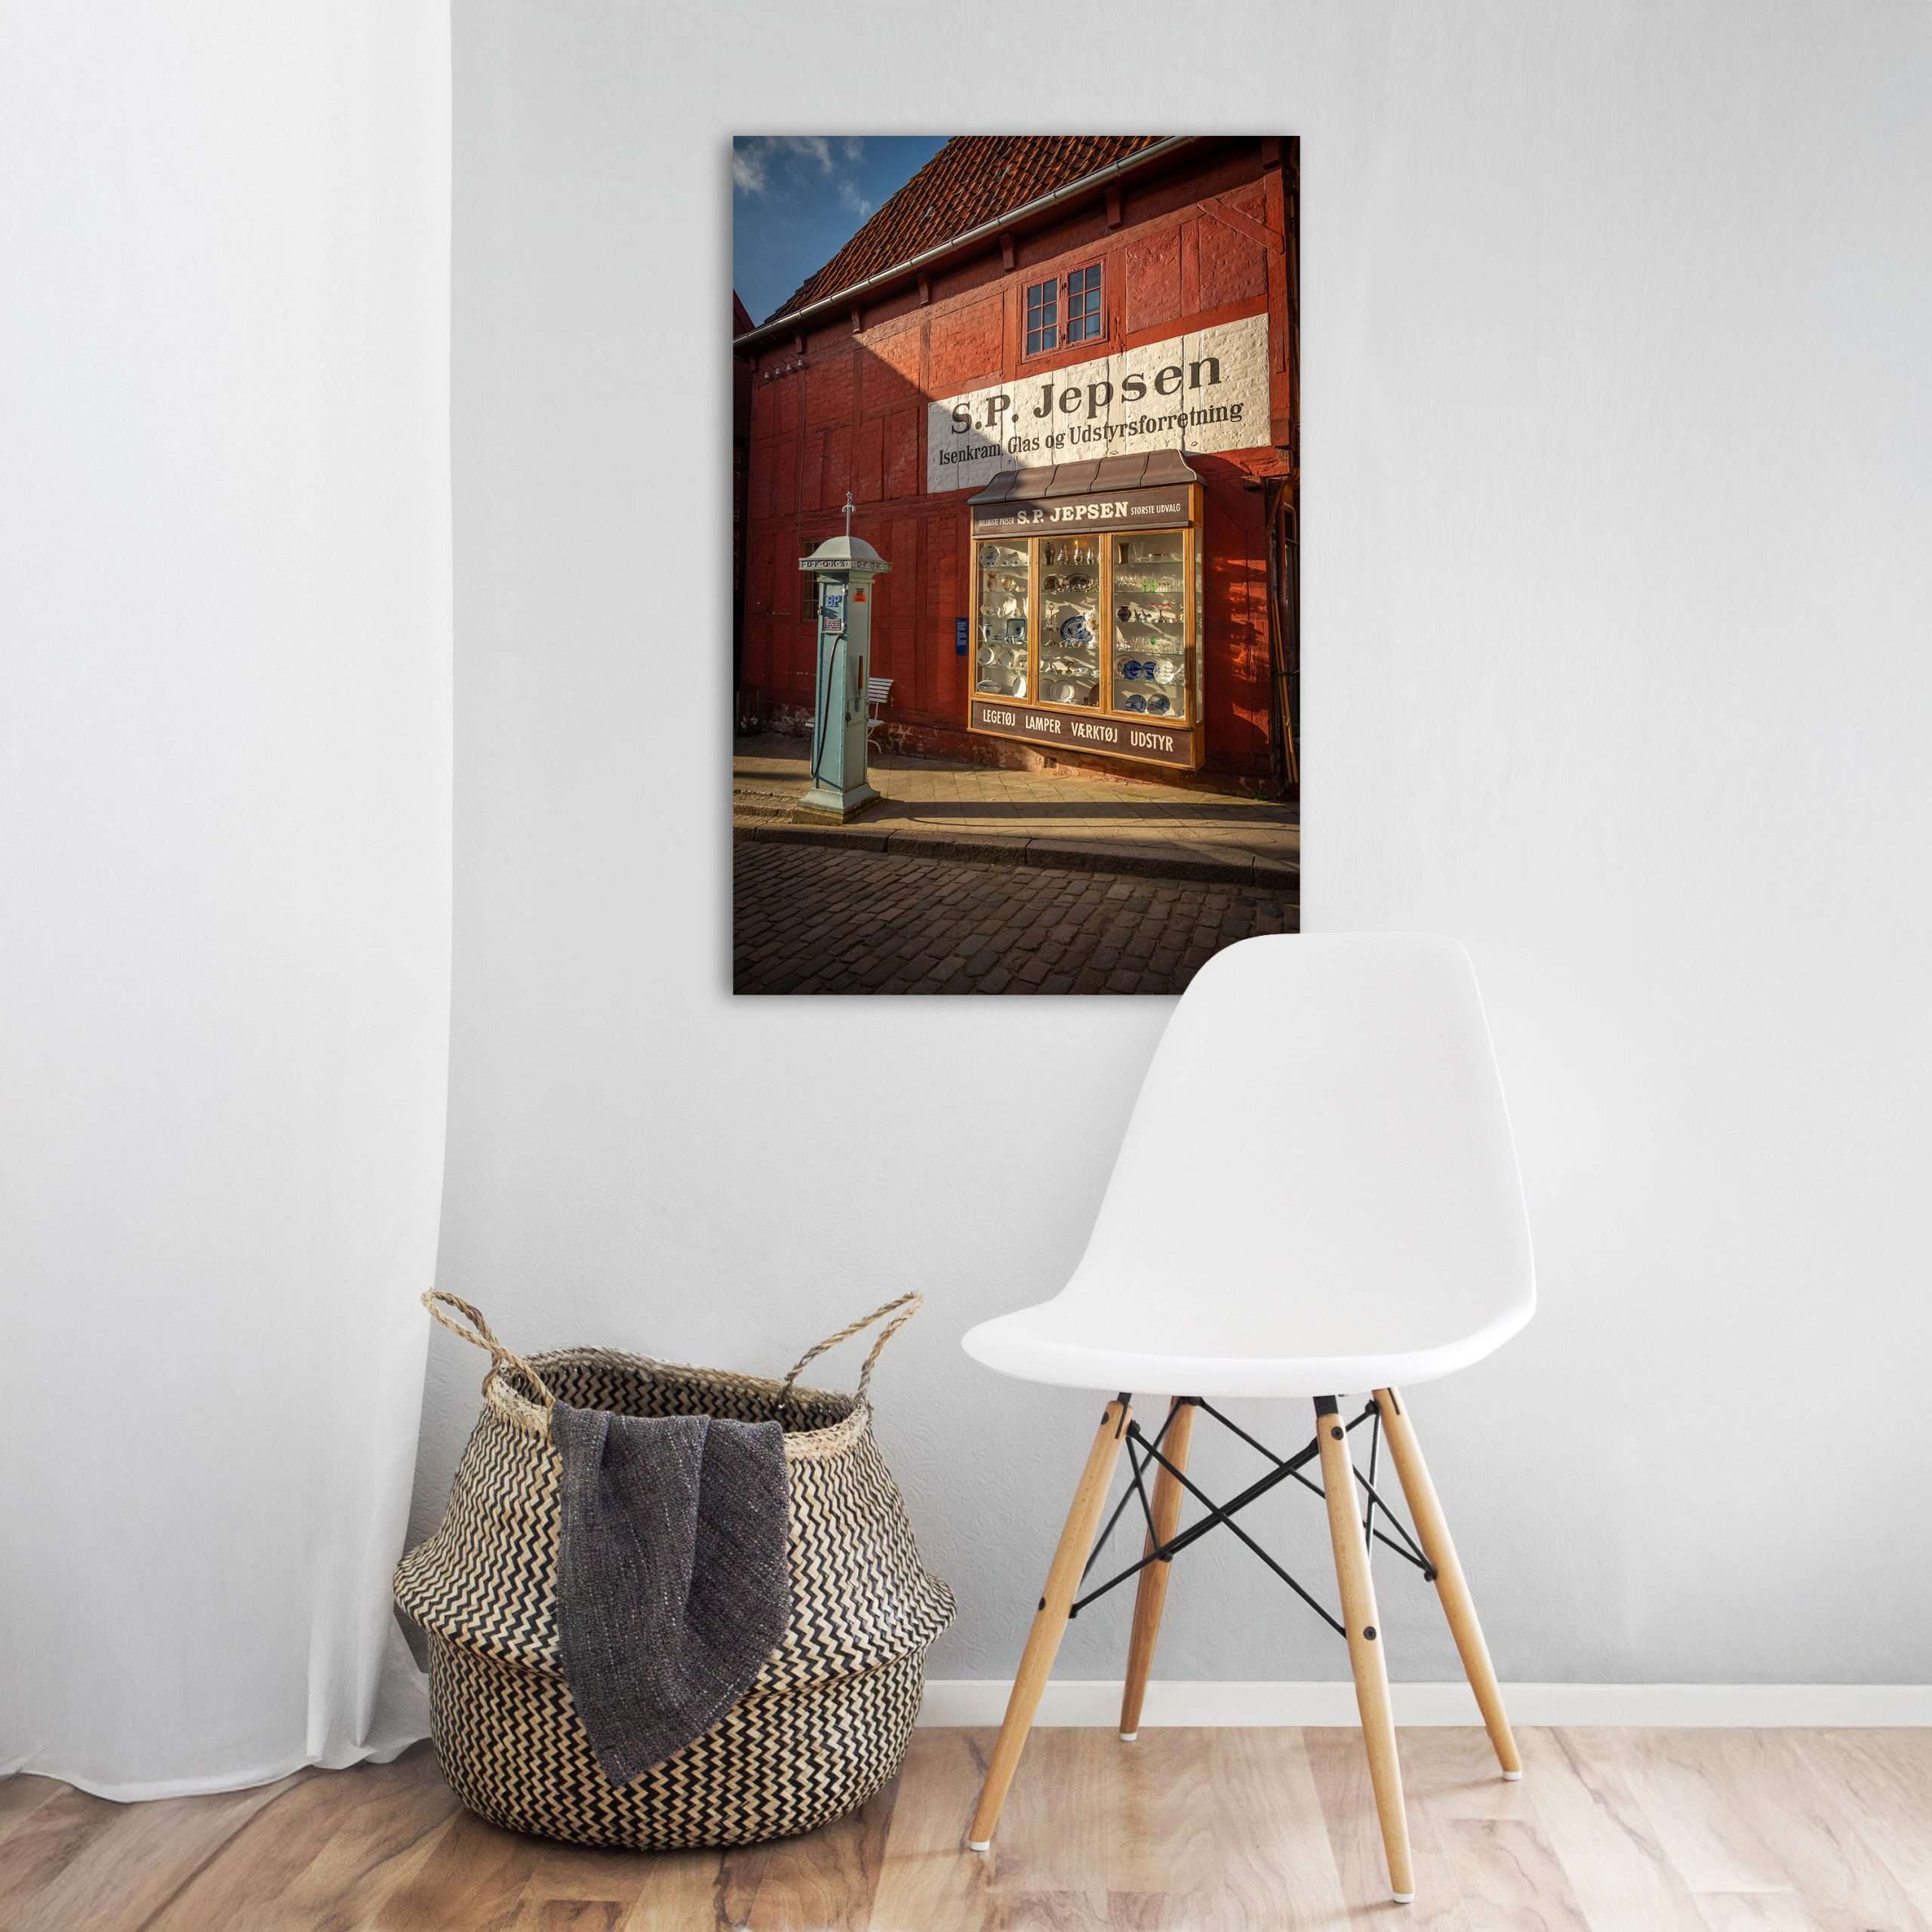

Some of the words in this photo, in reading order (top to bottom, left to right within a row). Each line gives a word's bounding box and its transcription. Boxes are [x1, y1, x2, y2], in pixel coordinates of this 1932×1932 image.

[1033, 356, 1222, 419] Jepsen
[1008, 435, 1040, 454] Glas
[1045, 432, 1066, 450] og
[1069, 402, 1244, 445] Udstyrsforretning
[1050, 501, 1129, 523] JEPSEN
[1131, 505, 1155, 515] STØRSTE
[1156, 503, 1181, 513] UDVALG
[826, 595, 842, 608] BP
[983, 709, 1016, 727] LEGETØJ
[1025, 715, 1061, 734] LAMPER
[1071, 721, 1118, 743] VÆRKTØJ
[1131, 731, 1174, 752] UDSTYR
